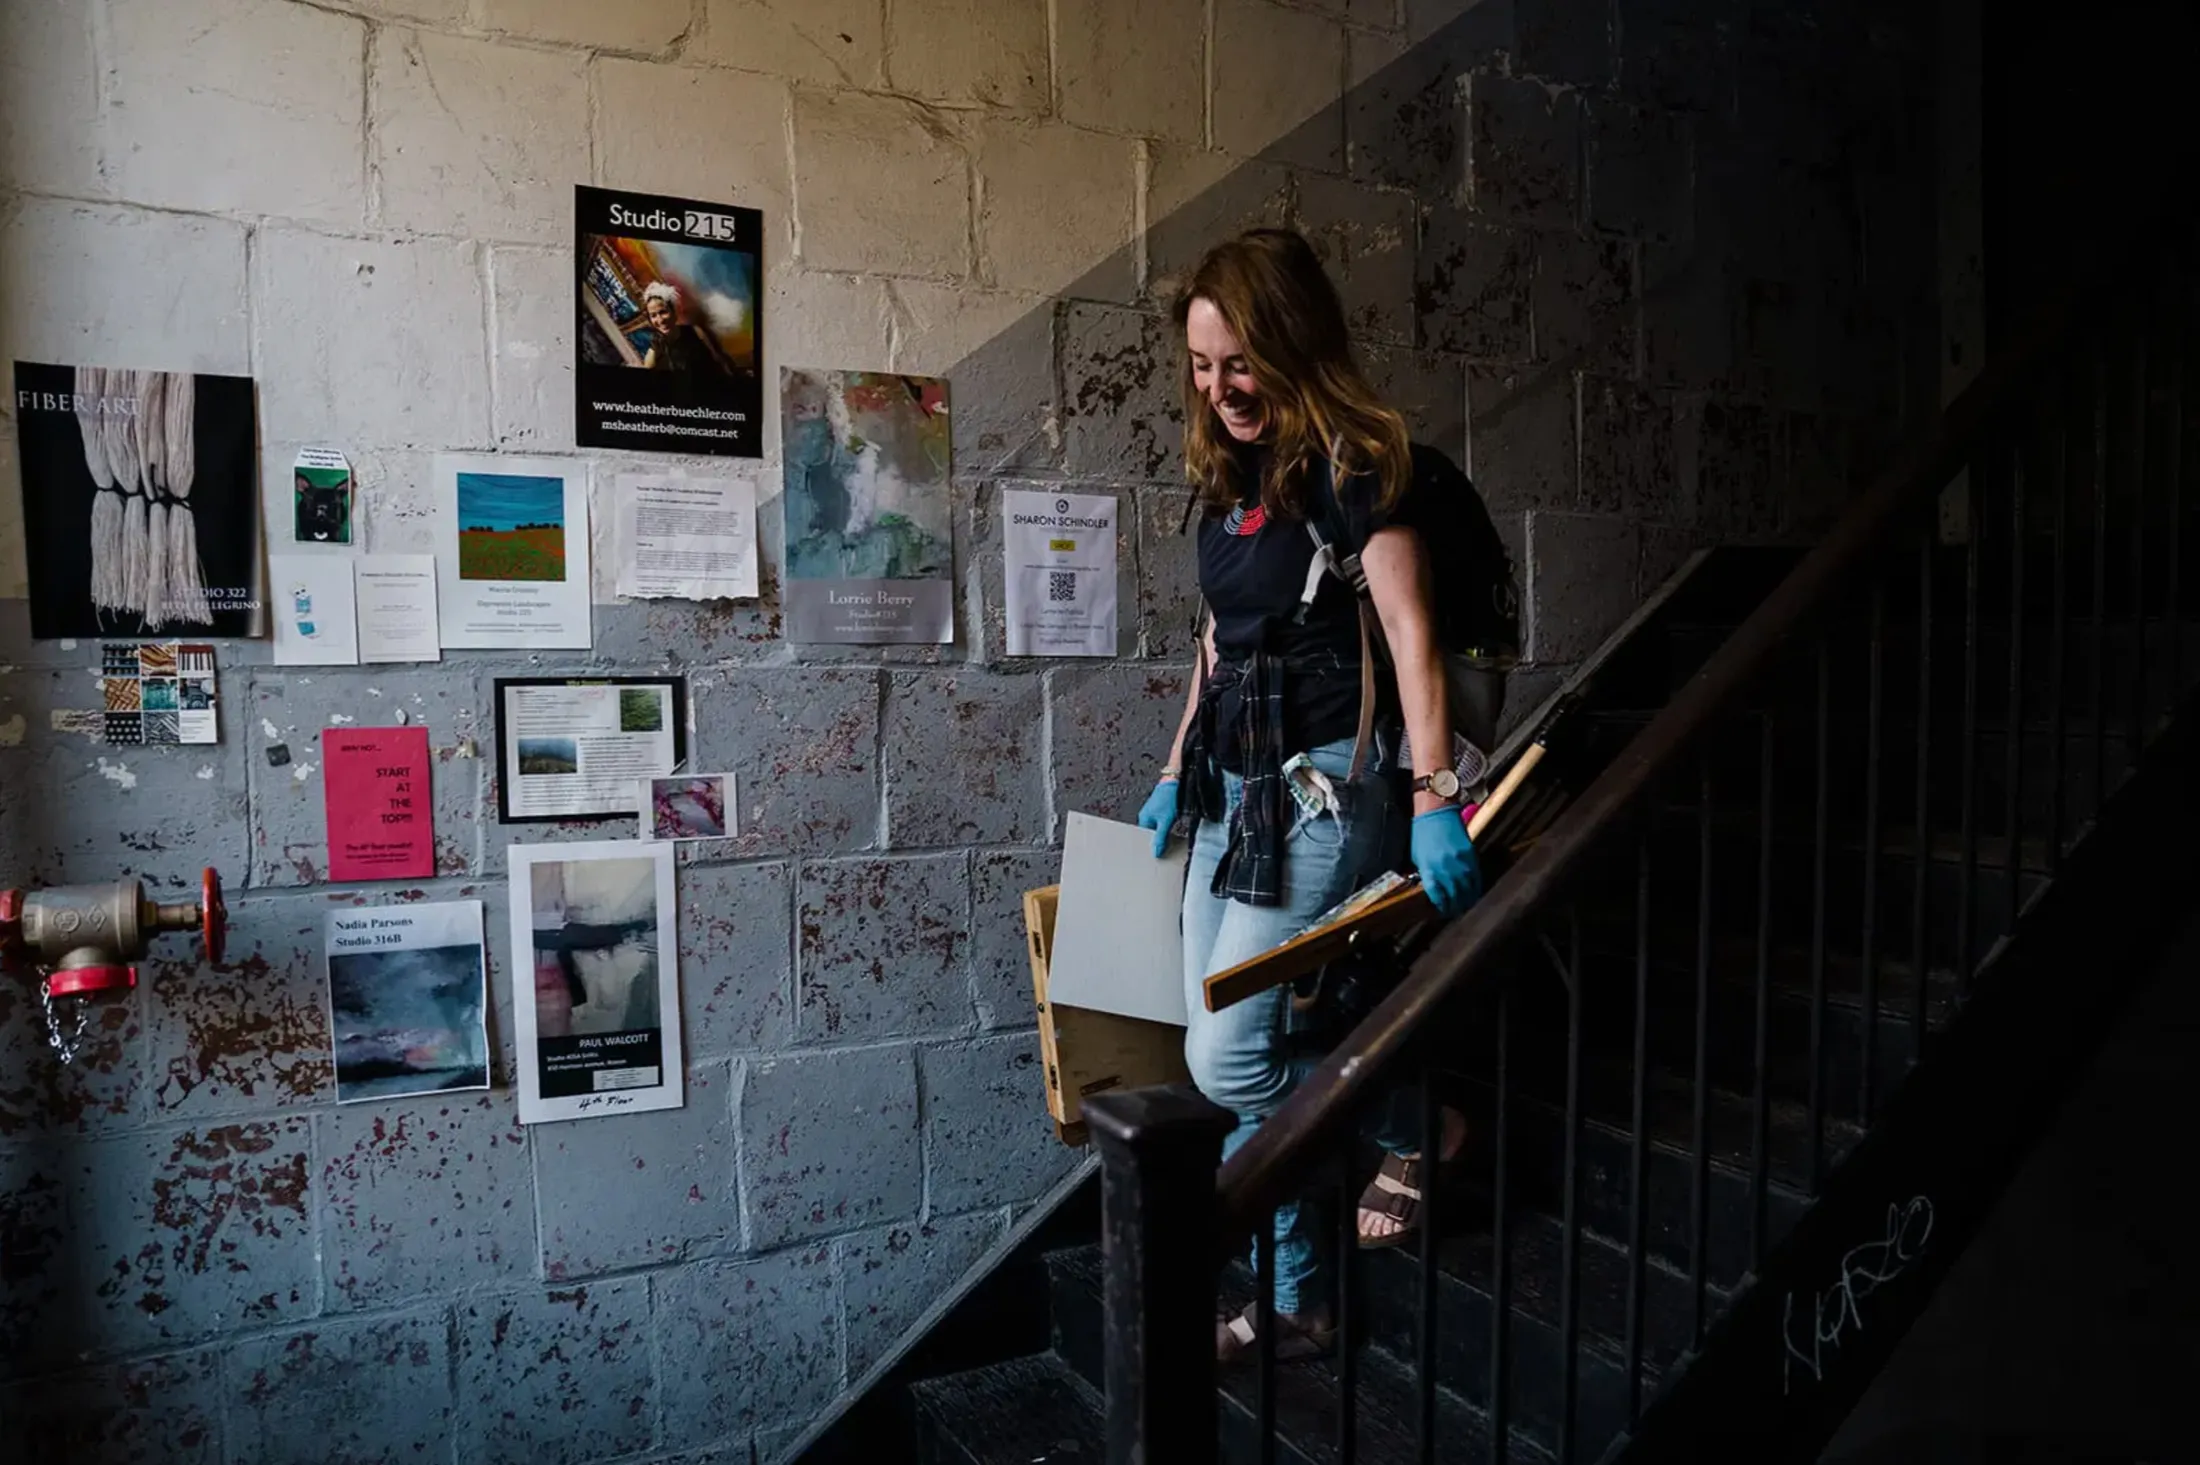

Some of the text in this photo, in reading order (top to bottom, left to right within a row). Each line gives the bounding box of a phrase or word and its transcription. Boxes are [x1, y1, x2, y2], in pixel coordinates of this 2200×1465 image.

[609, 203, 736, 242] Studio 215
[18, 391, 141, 416] FIBER ART
[592, 400, 746, 422] www.heatherbuechler.com
[601, 419, 739, 440] msheatherb@comcast.net
[1013, 514, 1109, 529] SHARON SCHINDLER
[227, 587, 247, 598] 322
[829, 590, 915, 608] Lorrie Berry
[376, 767, 411, 778] START
[396, 782, 411, 793] AT
[390, 798, 413, 809] THE
[335, 918, 414, 931] Nadia Parsons
[335, 934, 403, 947] Studio 316B
[578, 1033, 650, 1048] PAUL WALCOTT
